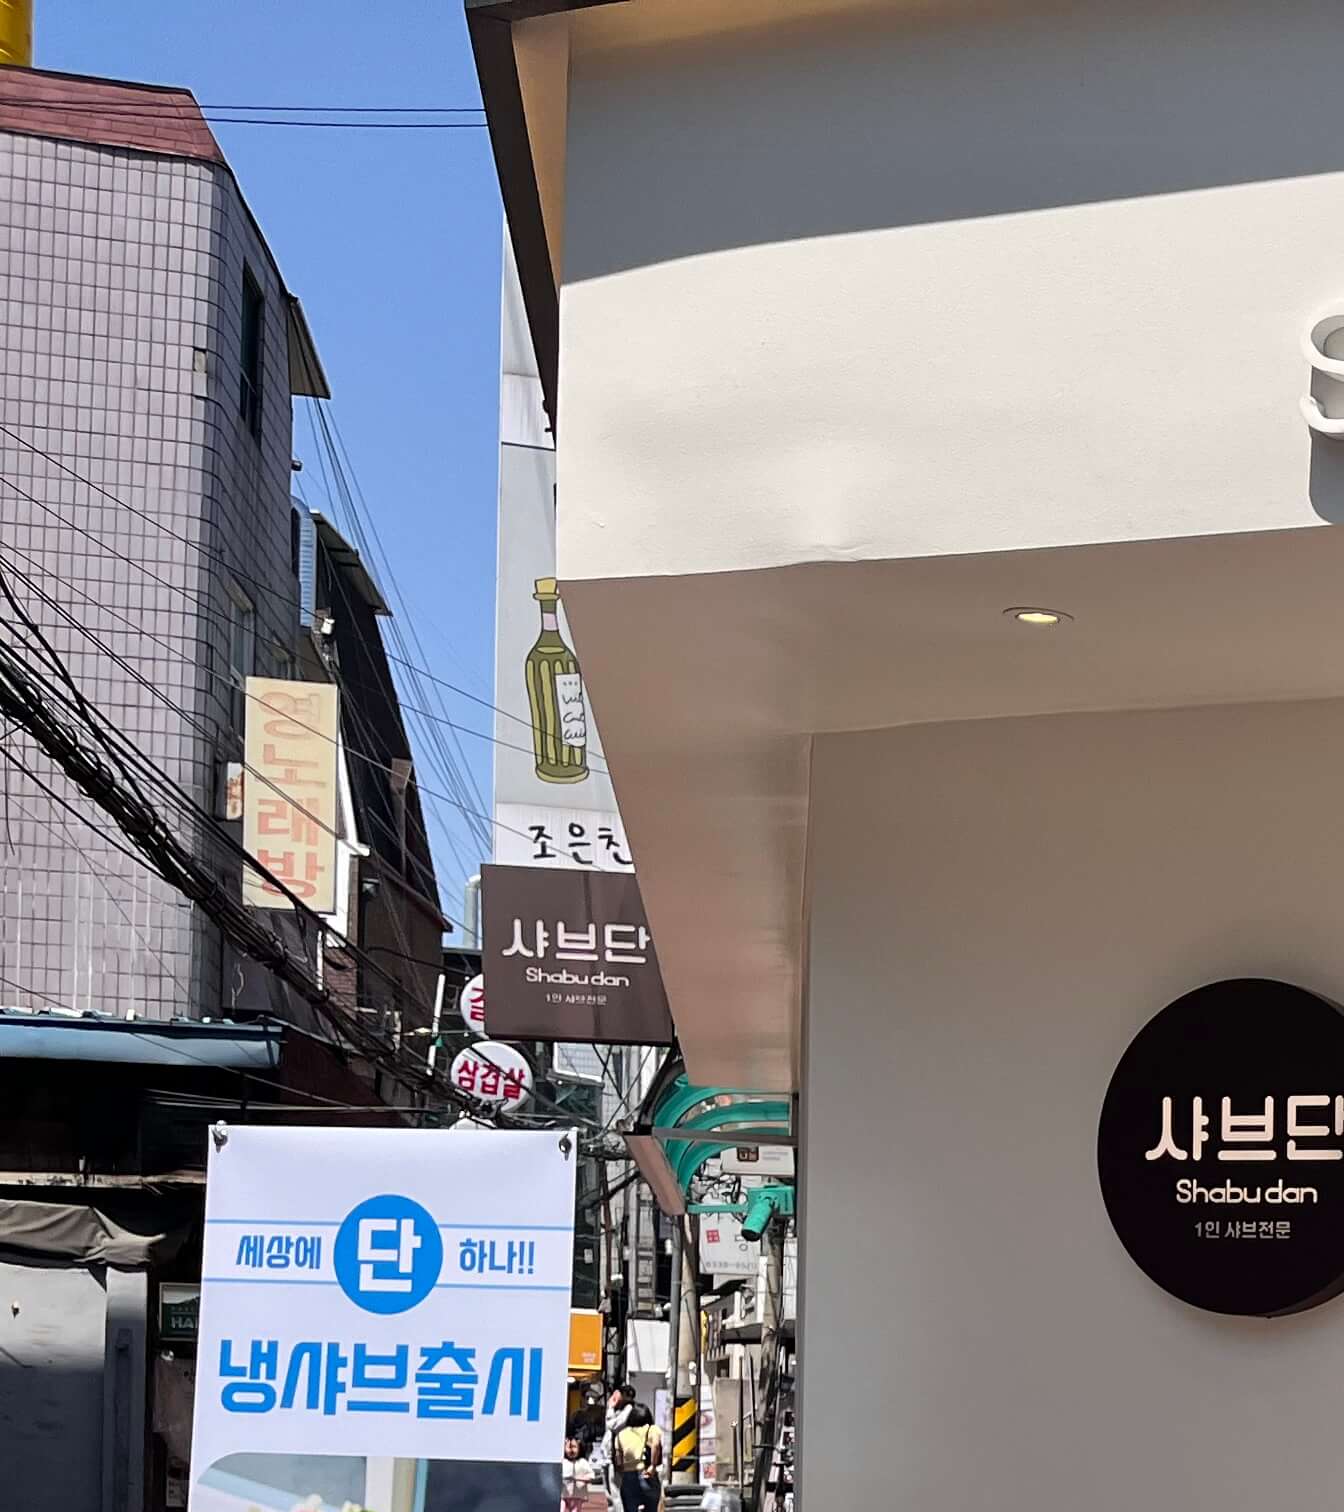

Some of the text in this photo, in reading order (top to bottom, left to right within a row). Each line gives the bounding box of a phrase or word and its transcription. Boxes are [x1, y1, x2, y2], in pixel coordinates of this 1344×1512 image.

[502, 918, 650, 964] 샤브단
[525, 967, 630, 987] Shabu dan
[1176, 1179, 1318, 1204] Shabu dan
[1194, 1221, 1291, 1239] 1인 샤브전문
[235, 1217, 535, 1293] 세상에 단 하나!!
[219, 1339, 543, 1422] 냉샤브출시
